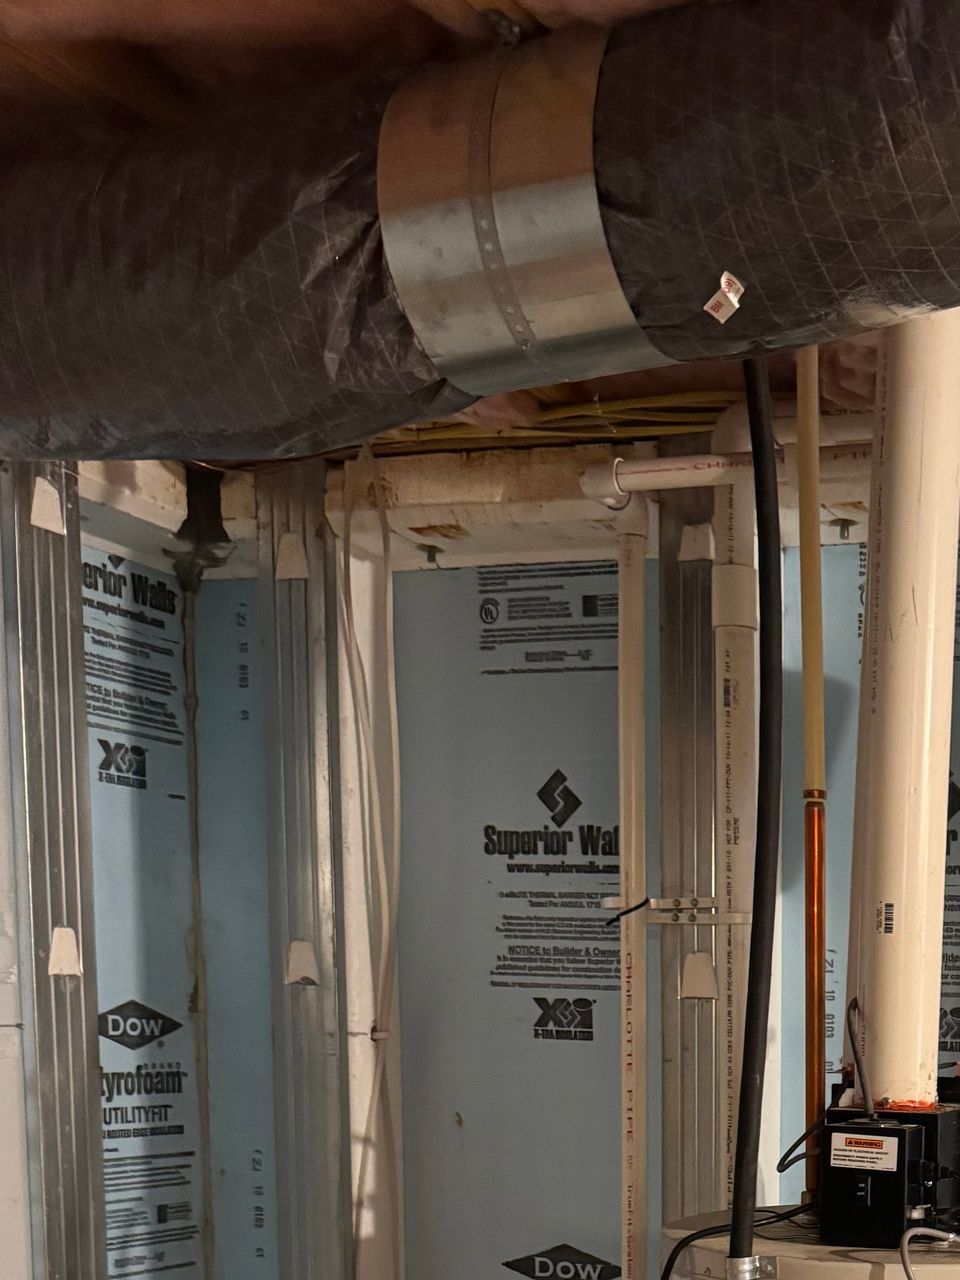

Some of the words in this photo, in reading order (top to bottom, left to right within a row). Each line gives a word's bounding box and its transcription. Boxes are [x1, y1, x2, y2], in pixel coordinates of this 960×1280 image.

[484, 824, 574, 860] Superior
[106, 1014, 164, 1037] DOW
[625, 952, 634, 1075] CHARLOTTE
[100, 1066, 184, 1102] tyrofoam
[103, 1105, 170, 1124] UTILITYFIT
[625, 1089, 634, 1144] PIPE
[533, 1257, 606, 1280] DOW
